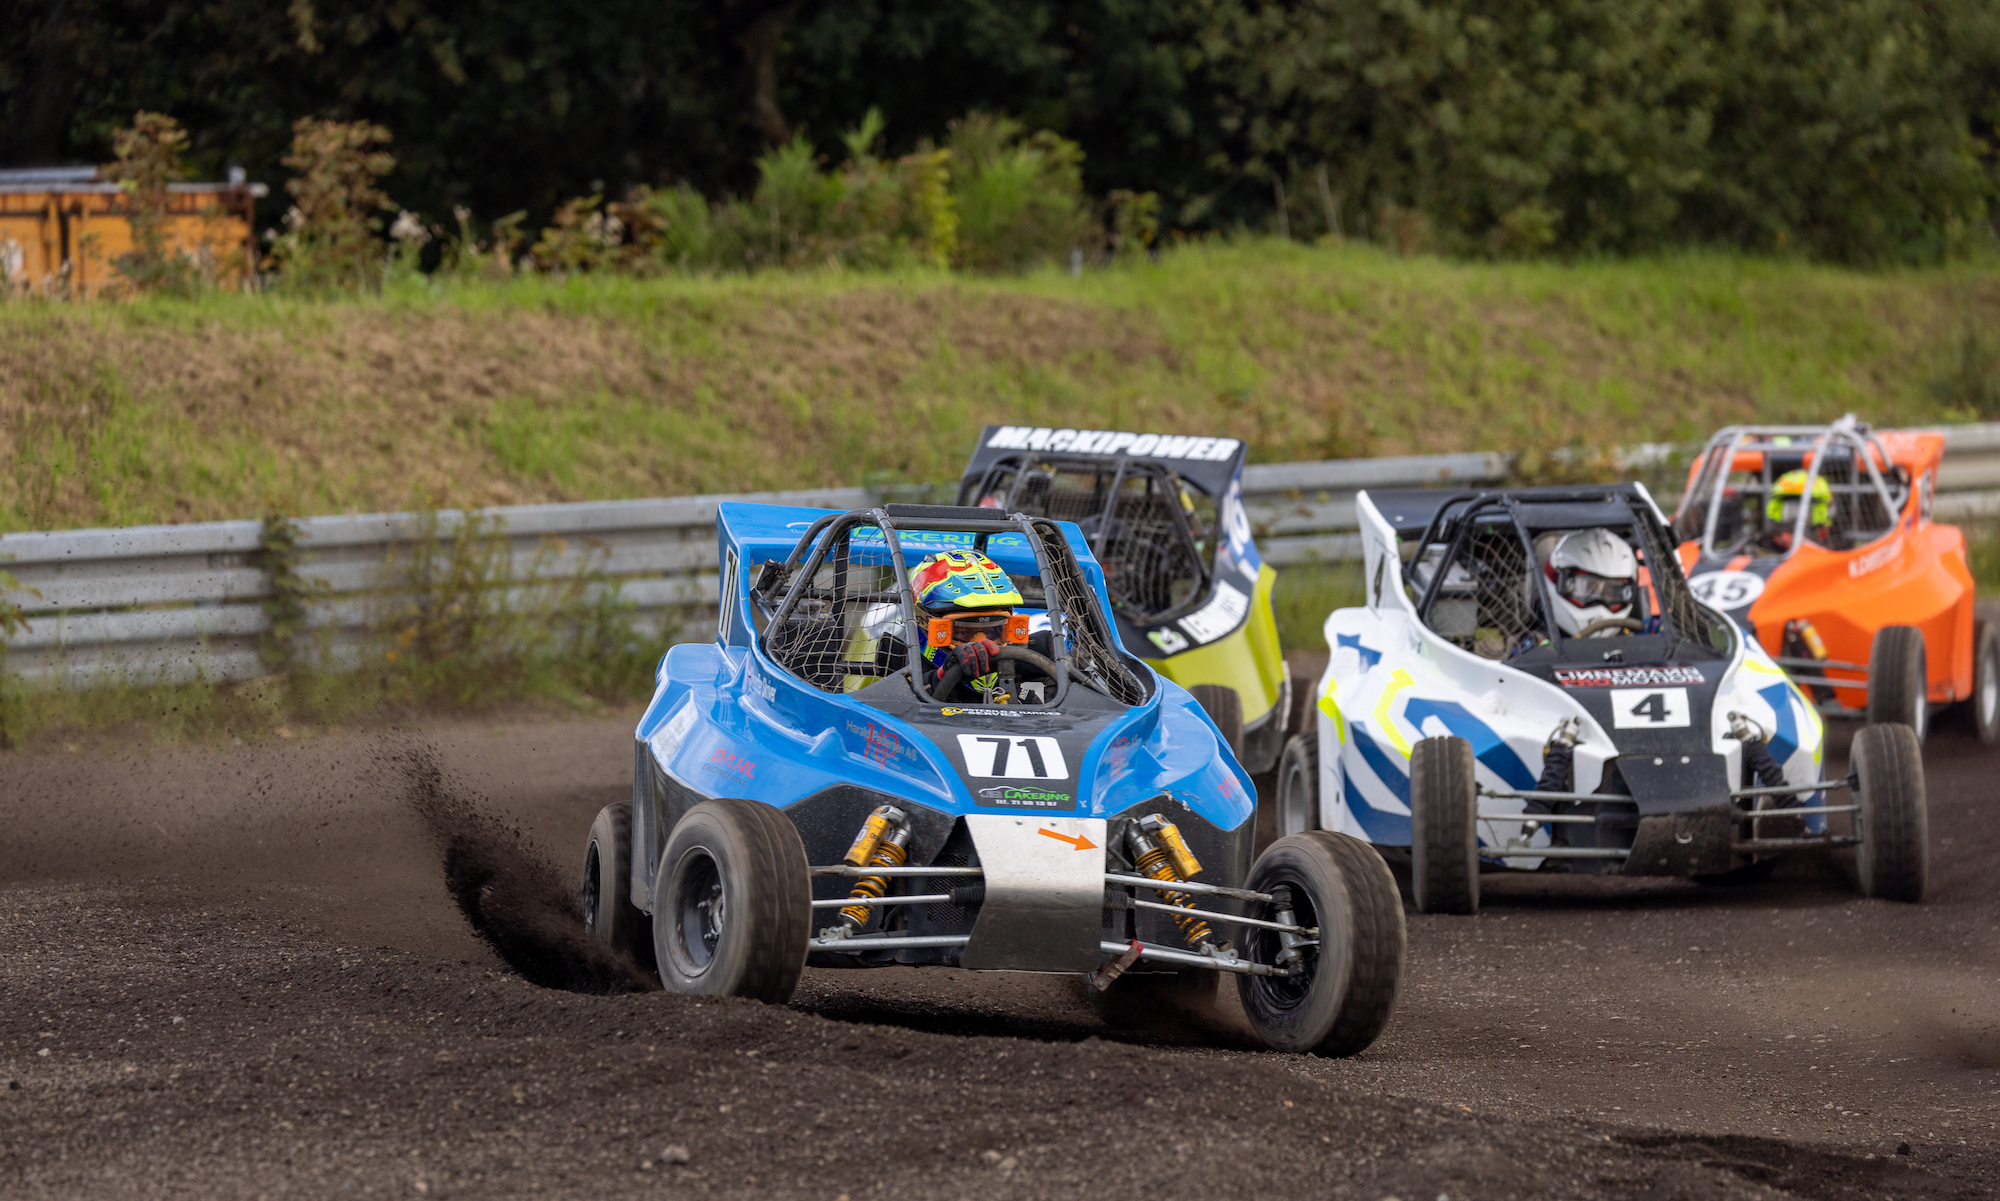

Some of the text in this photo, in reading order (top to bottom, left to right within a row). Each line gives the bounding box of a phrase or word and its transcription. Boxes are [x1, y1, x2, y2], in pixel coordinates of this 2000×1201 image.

[987, 425, 1240, 462] MACKIPOWER
[1629, 693, 1672, 722] 4
[710, 748, 757, 779] DAHL
[976, 736, 1048, 778] 71
[701, 763, 750, 788] ENGINEERING
